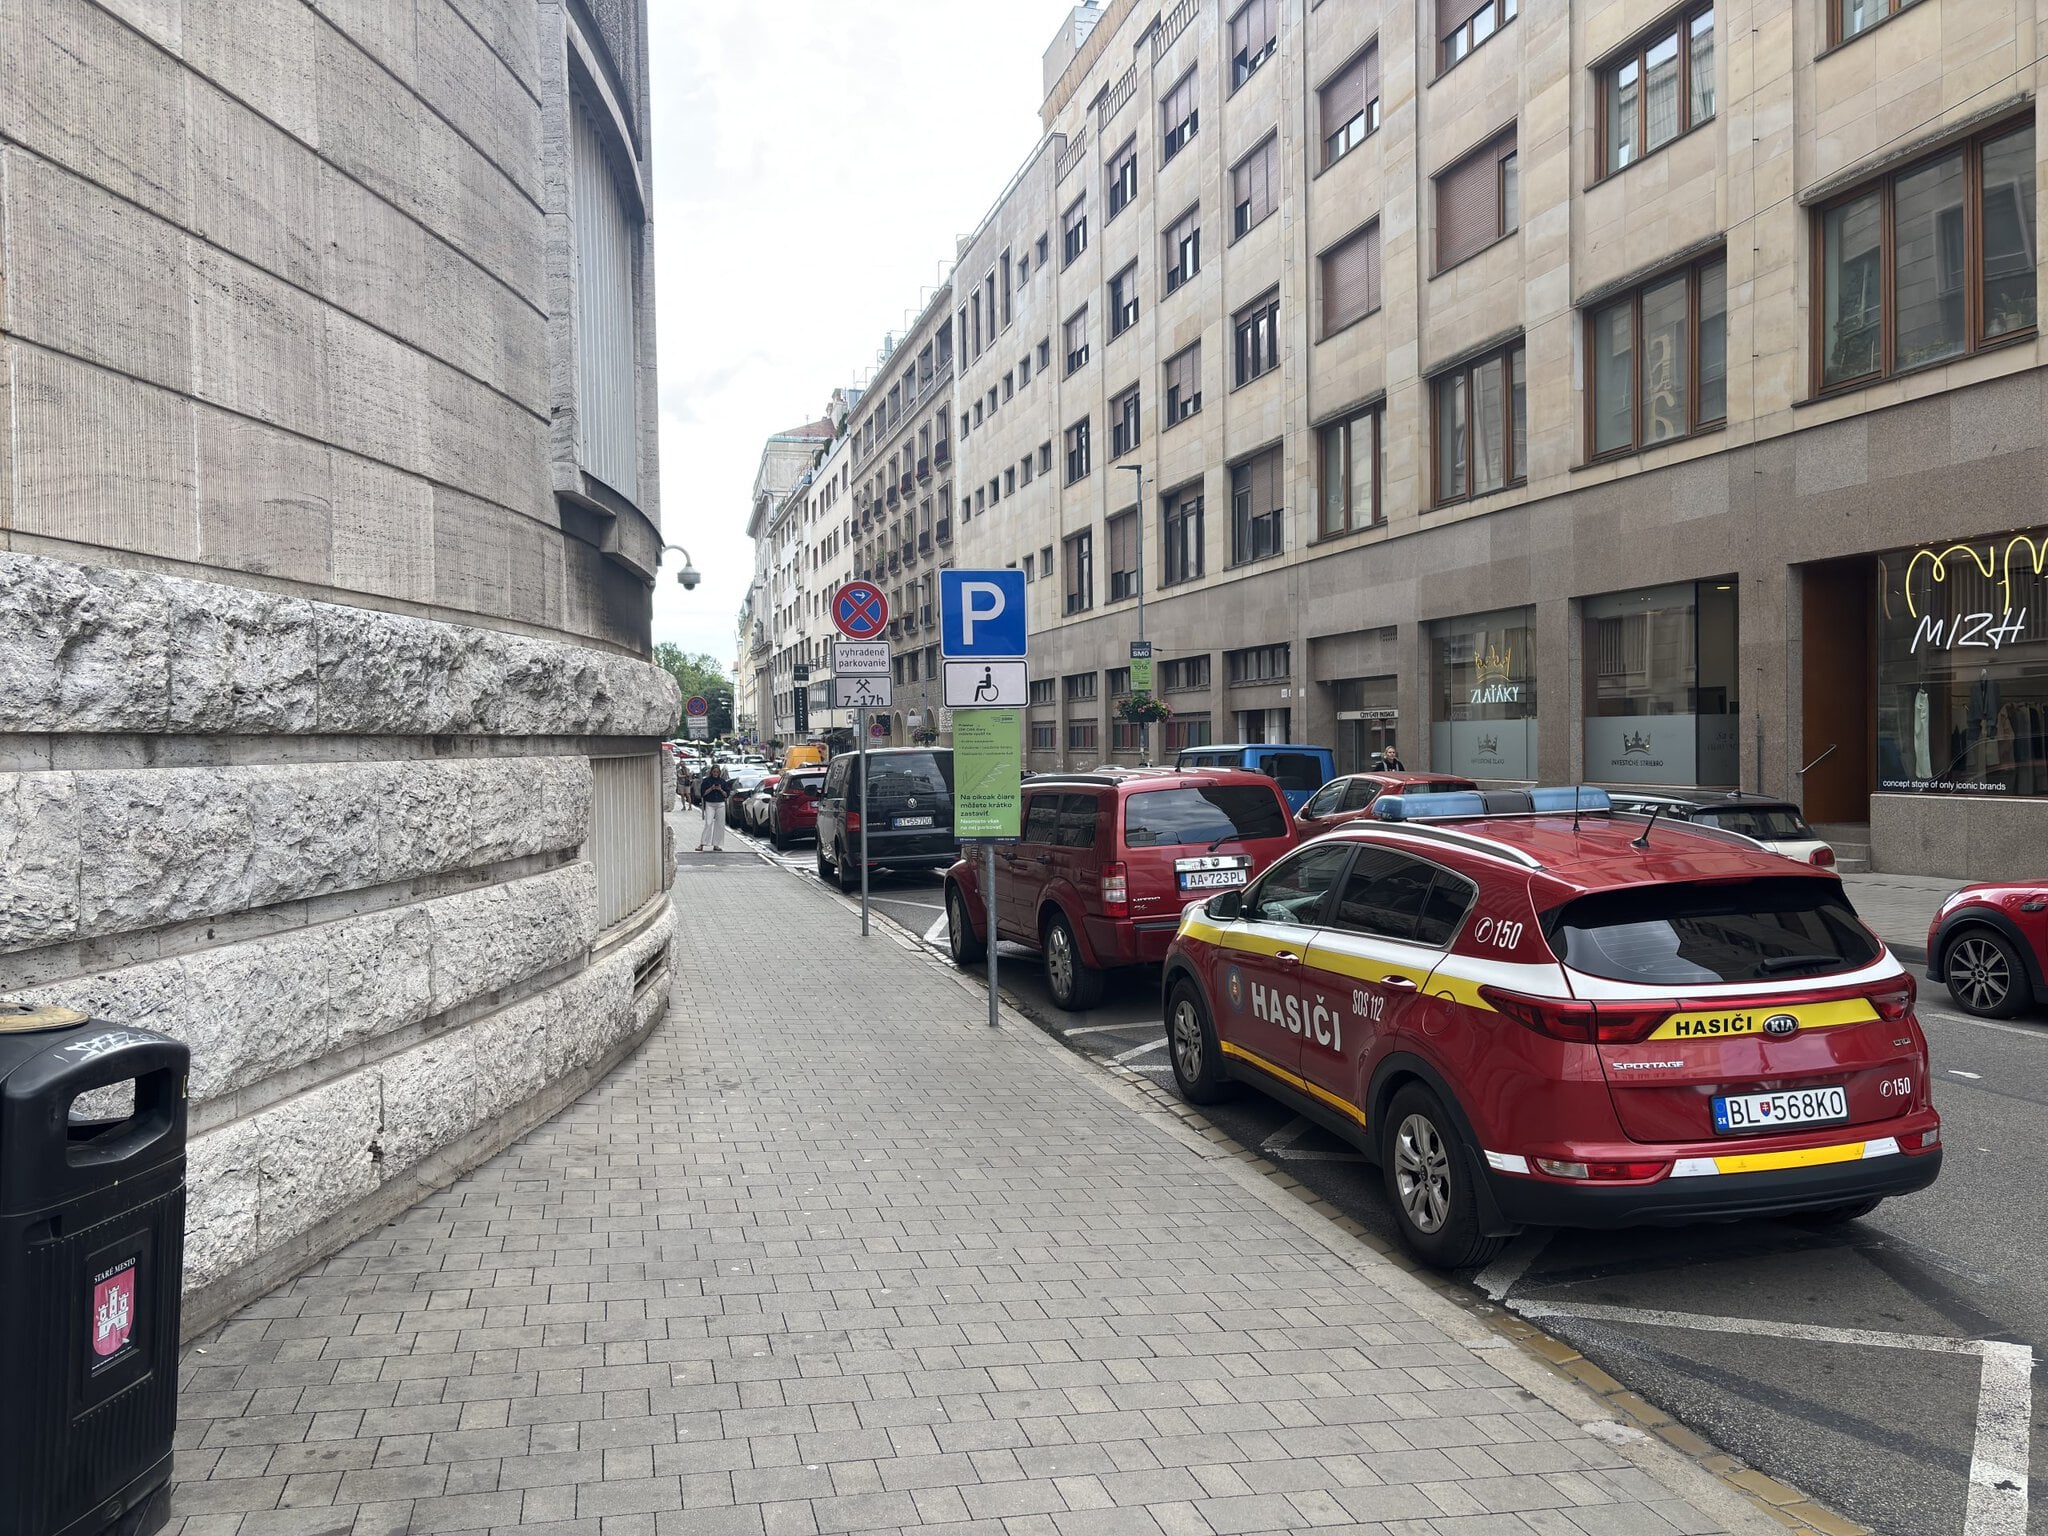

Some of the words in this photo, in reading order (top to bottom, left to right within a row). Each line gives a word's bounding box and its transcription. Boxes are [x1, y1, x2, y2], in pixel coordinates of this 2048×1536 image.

[961, 582, 1006, 645] P
[1910, 607, 2027, 654] MIZH
[839, 648, 885, 658] vyhradené
[838, 660, 887, 669] parkovanie
[1882, 780, 1910, 789] concept
[1911, 780, 1929, 788] store
[1939, 781, 1954, 791] only
[1956, 781, 1978, 790] iconic
[1979, 782, 2007, 791] brands
[1492, 919, 1523, 950] 150
[1251, 981, 1341, 1052] HASIČI
[1352, 989, 1369, 1018] SOS
[1370, 995, 1385, 1022] 112
[1676, 1014, 1752, 1036] HASIČI
[1771, 1019, 1794, 1032] KIA
[1612, 1060, 1685, 1071] SPORTAGE
[1892, 1077, 1911, 1096] 150
[94, 1266, 114, 1284] STARÉ
[114, 1256, 136, 1274] MESTO
